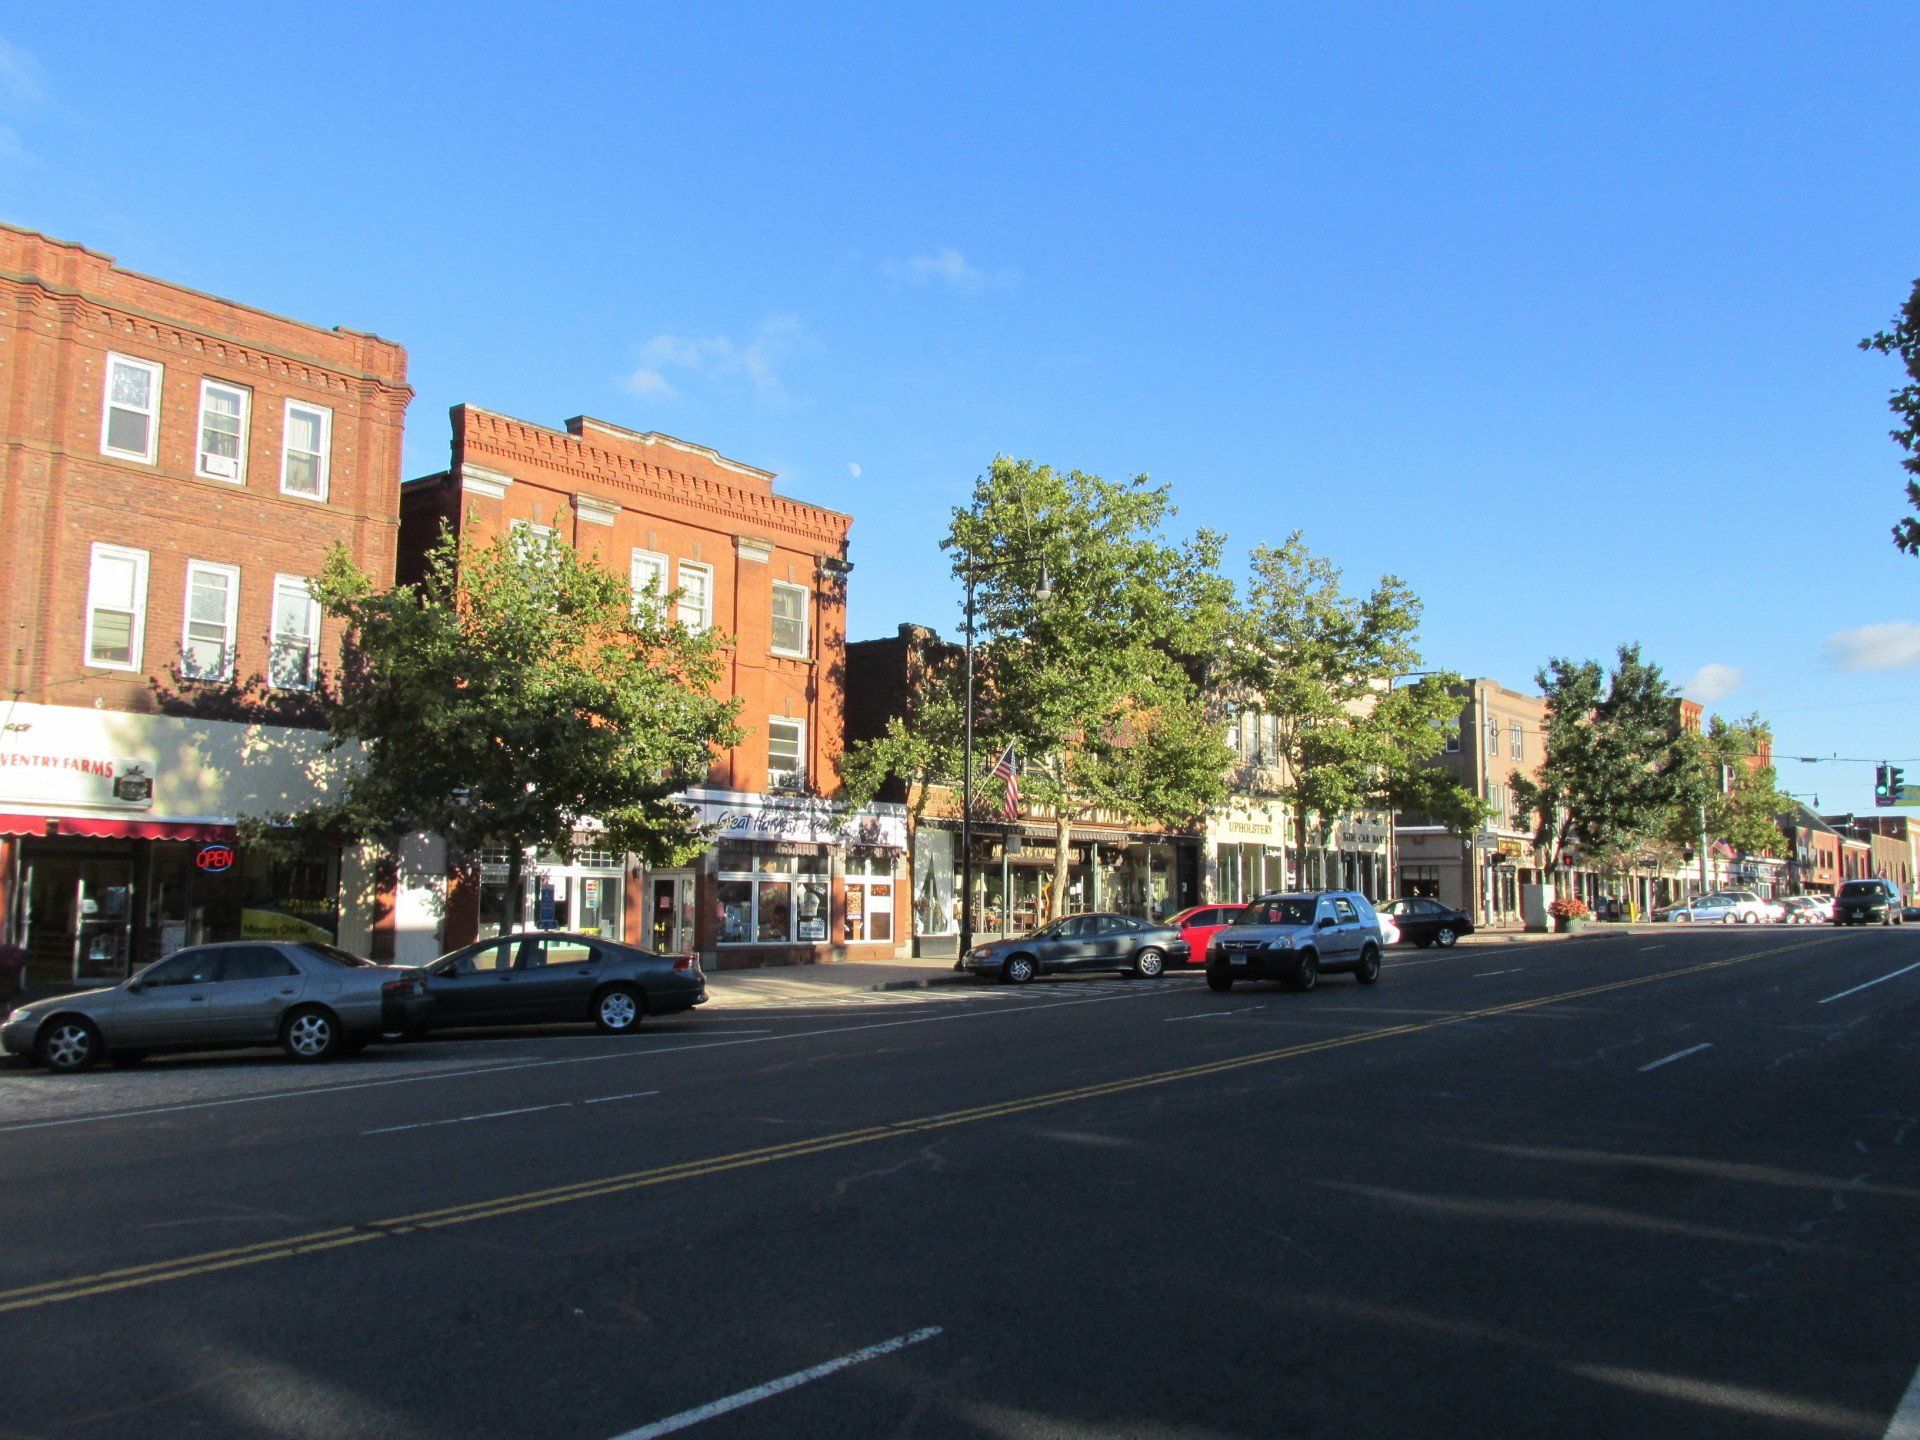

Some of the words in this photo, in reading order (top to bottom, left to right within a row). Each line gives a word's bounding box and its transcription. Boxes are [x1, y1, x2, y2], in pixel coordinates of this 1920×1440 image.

[62, 757, 114, 779] FARMS
[717, 810, 752, 831] Great
[753, 811, 799, 835] Harvest
[1229, 821, 1272, 835] UPHOLSTERY
[196, 850, 234, 868] OPEN
